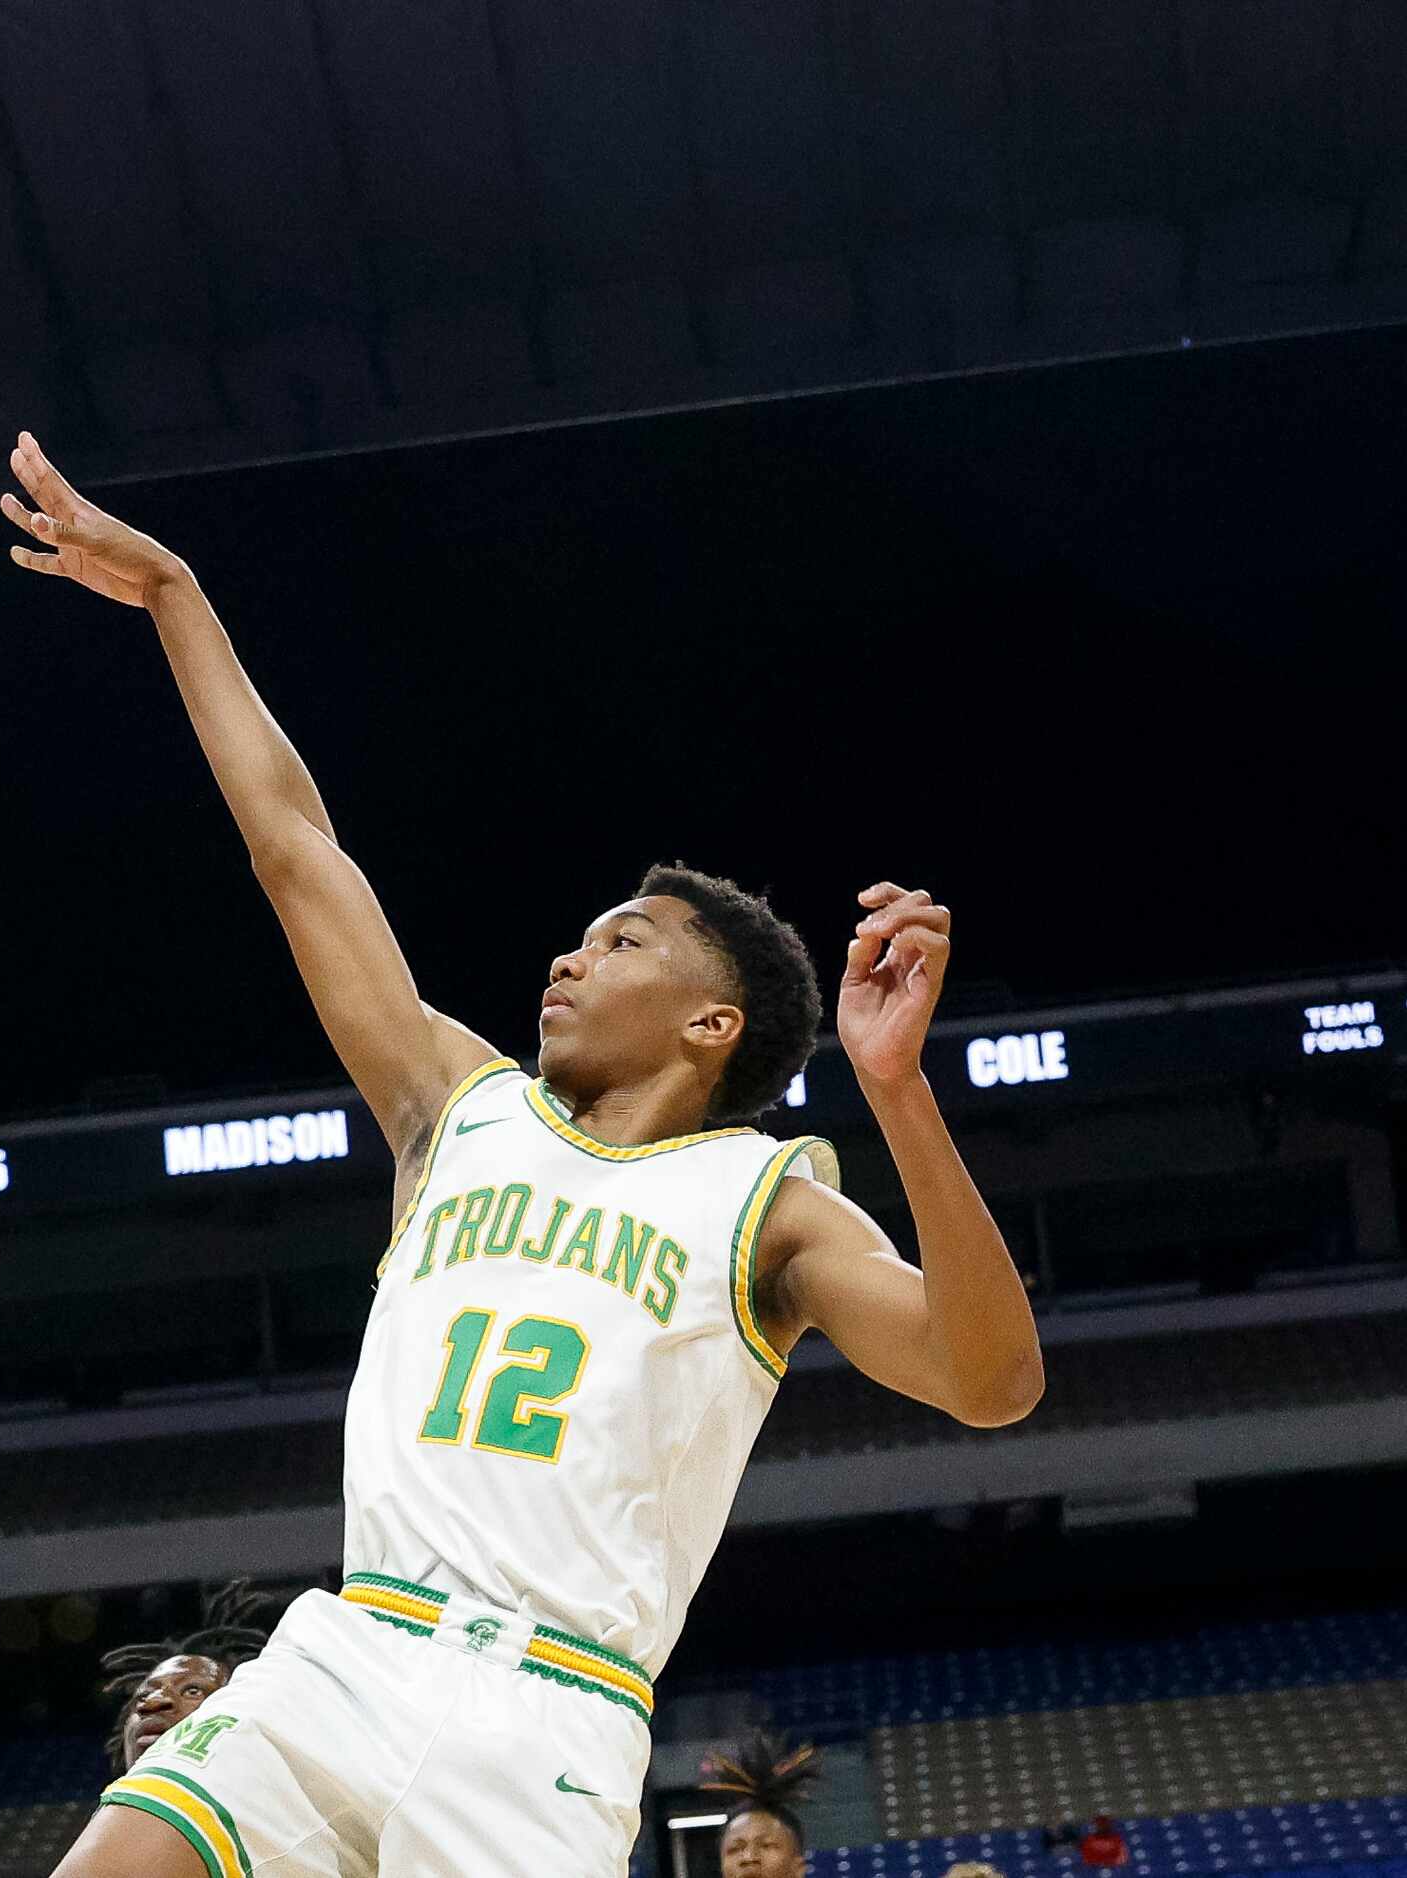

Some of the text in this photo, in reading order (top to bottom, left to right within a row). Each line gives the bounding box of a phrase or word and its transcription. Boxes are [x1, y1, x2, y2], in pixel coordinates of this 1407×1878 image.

[1302, 1025, 1384, 1055] FOULS
[1304, 1001, 1375, 1029] TEAM
[967, 1032, 1069, 1088] COLE
[164, 1109, 349, 1176] MADISON
[409, 1183, 690, 1328] TROJANS
[416, 1306, 592, 1465] 12
[148, 1714, 239, 1763] M
